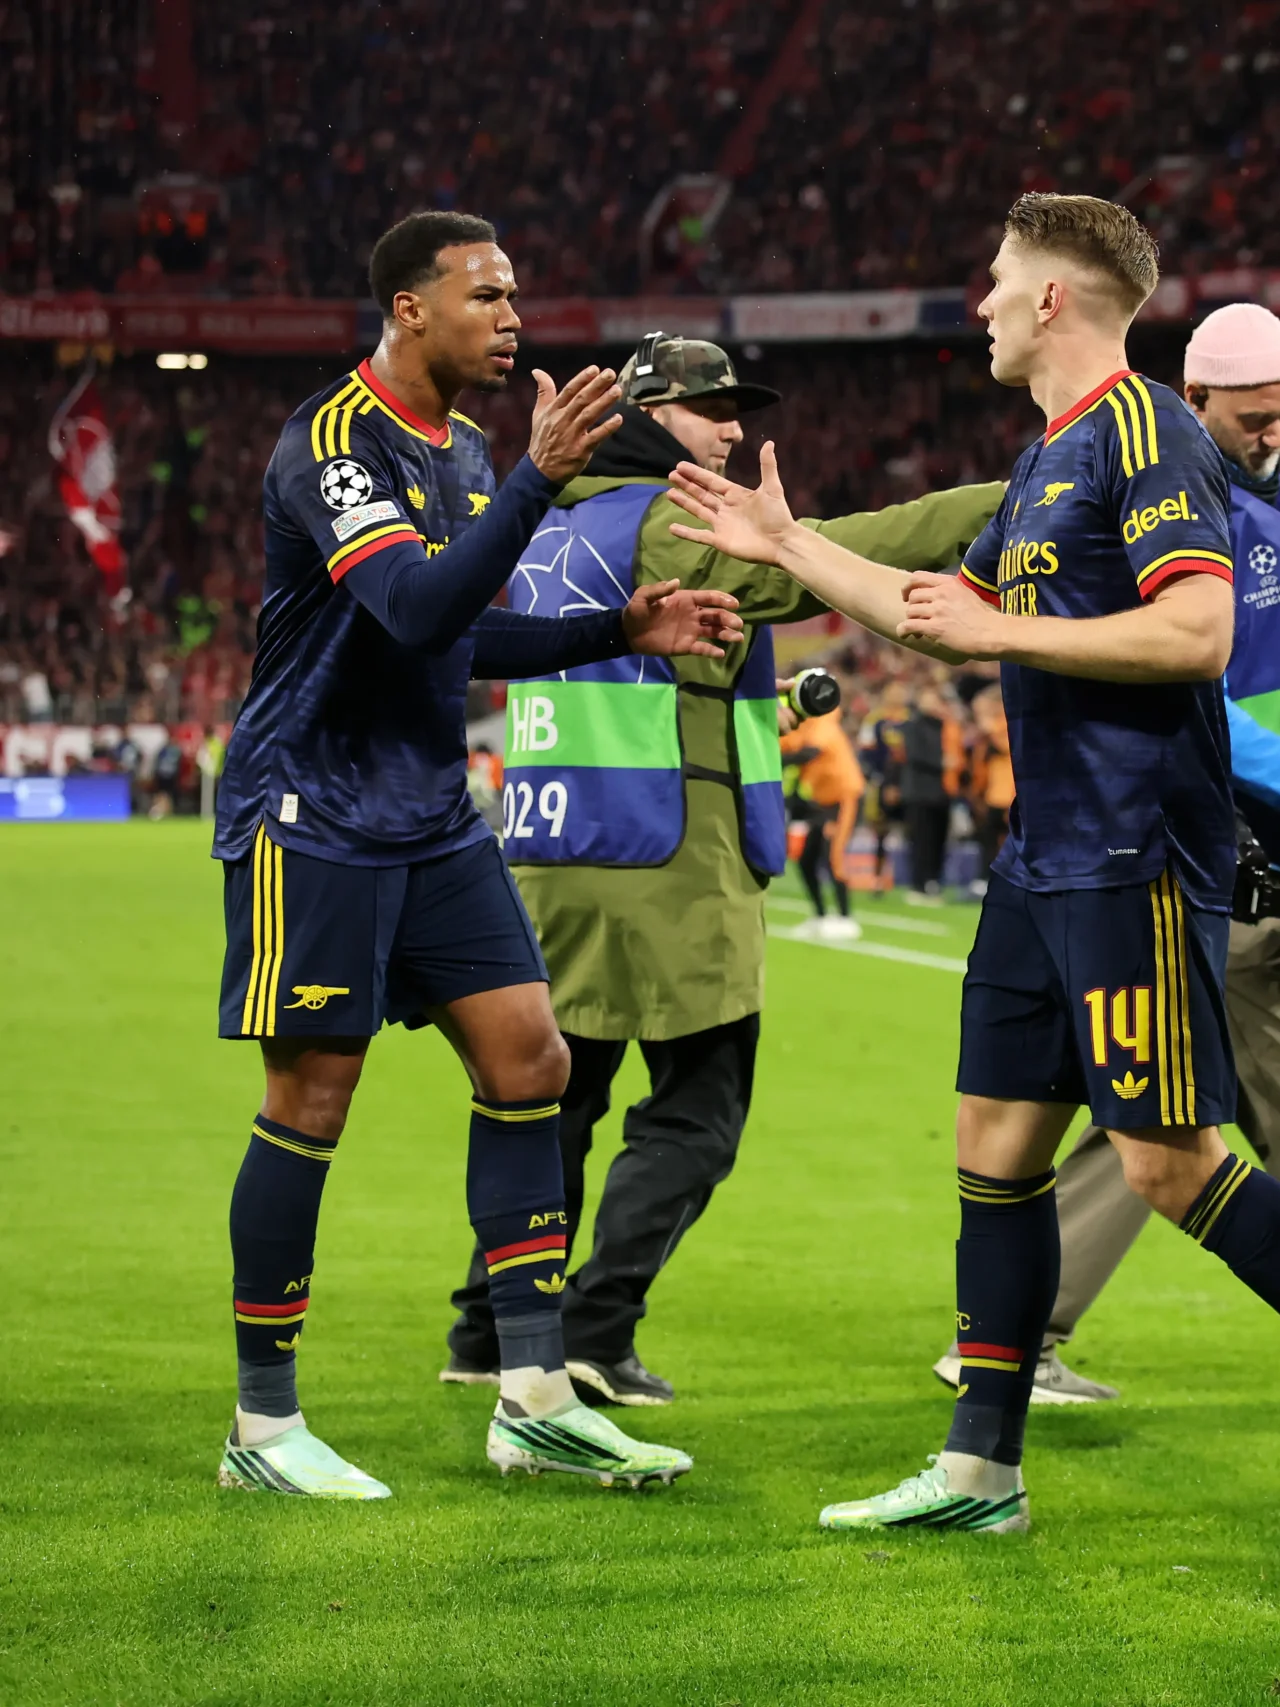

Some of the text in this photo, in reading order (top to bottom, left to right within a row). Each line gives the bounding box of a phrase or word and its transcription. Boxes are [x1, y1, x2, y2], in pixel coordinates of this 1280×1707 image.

[335, 505, 396, 535] FOUNDATION
[1121, 490, 1199, 545] deel.
[511, 696, 559, 752] HB
[503, 780, 569, 839] 029
[1083, 985, 1151, 1067] 14
[528, 1211, 568, 1230] AFC
[283, 1273, 312, 1295] AF
